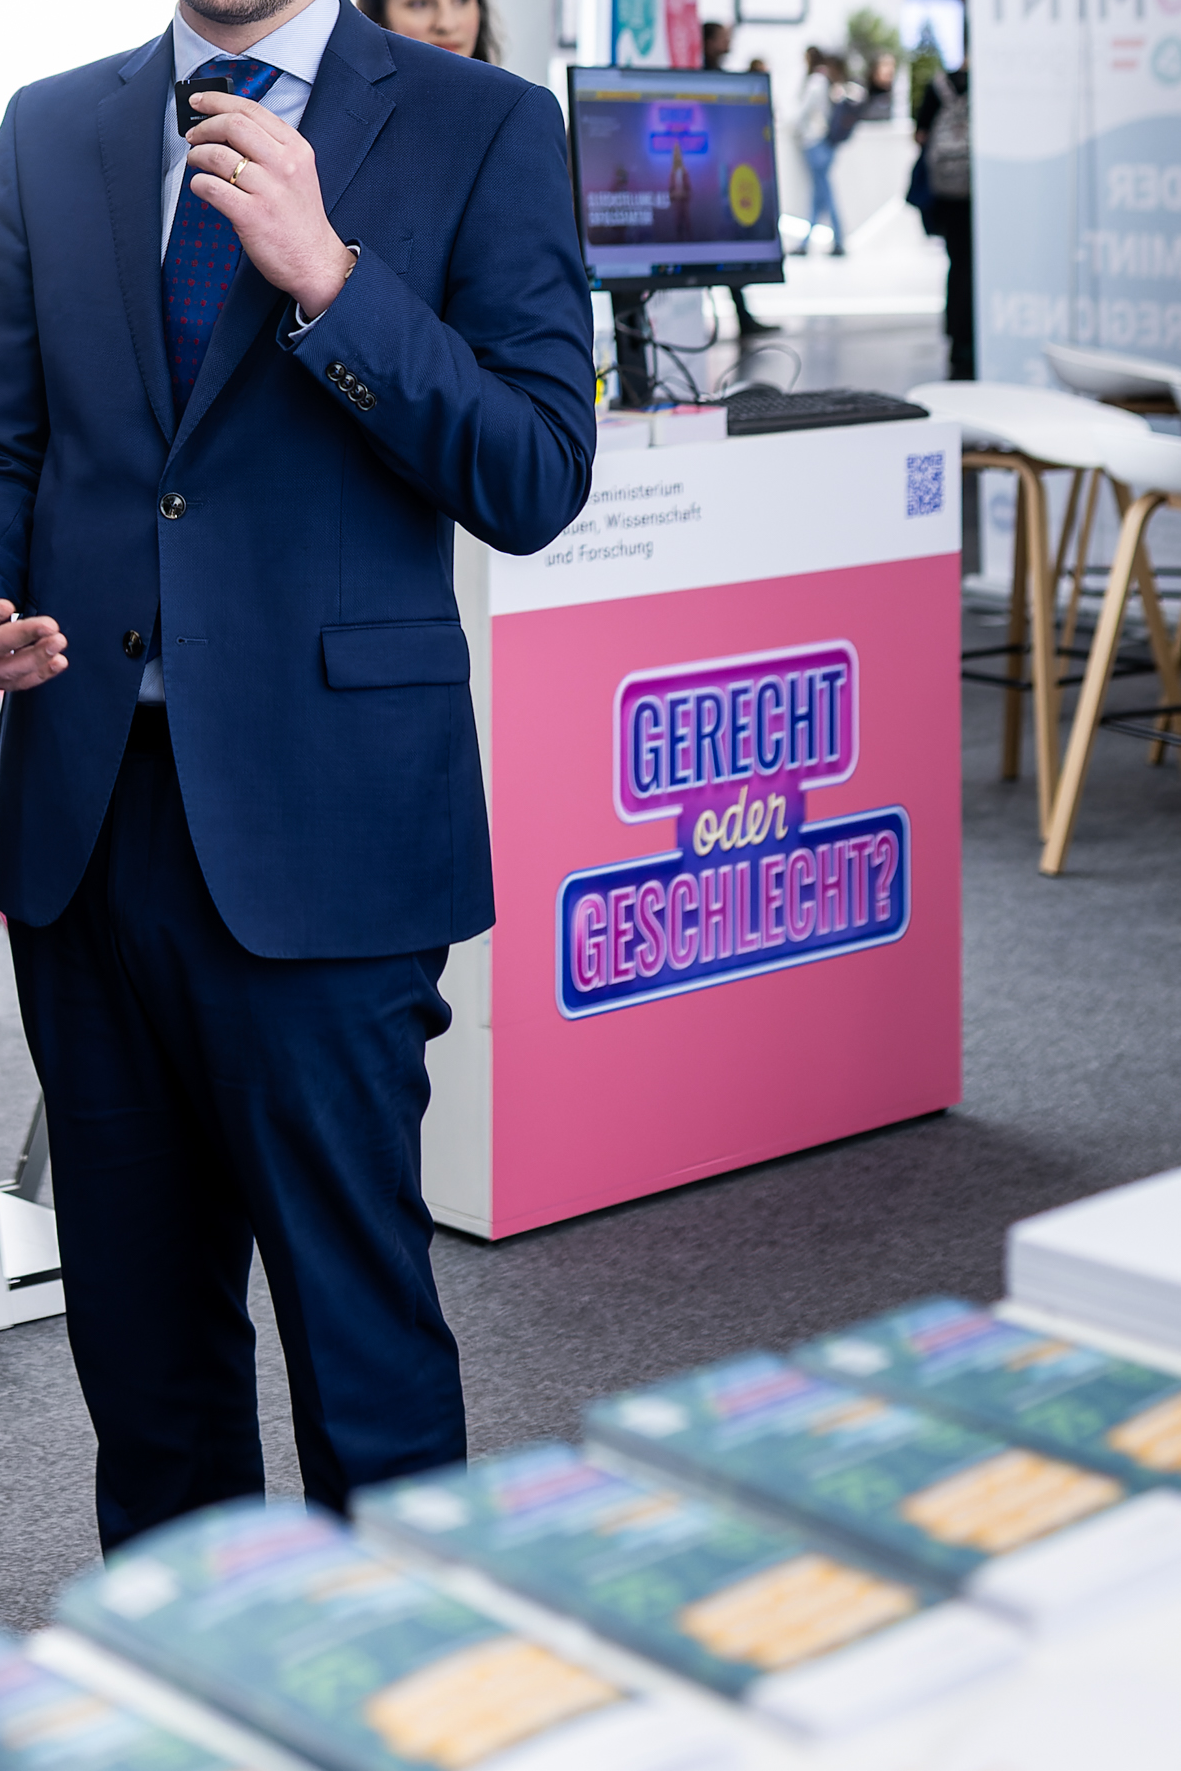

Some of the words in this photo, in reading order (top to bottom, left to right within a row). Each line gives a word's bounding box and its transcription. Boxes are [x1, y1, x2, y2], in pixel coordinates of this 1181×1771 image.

[606, 502, 701, 530] Wissenschaft
[546, 545, 573, 567] und
[578, 539, 654, 562] Forschung
[629, 663, 847, 799] GERECHT
[692, 784, 789, 856] oder
[570, 829, 900, 992] GESCHLECHT?
